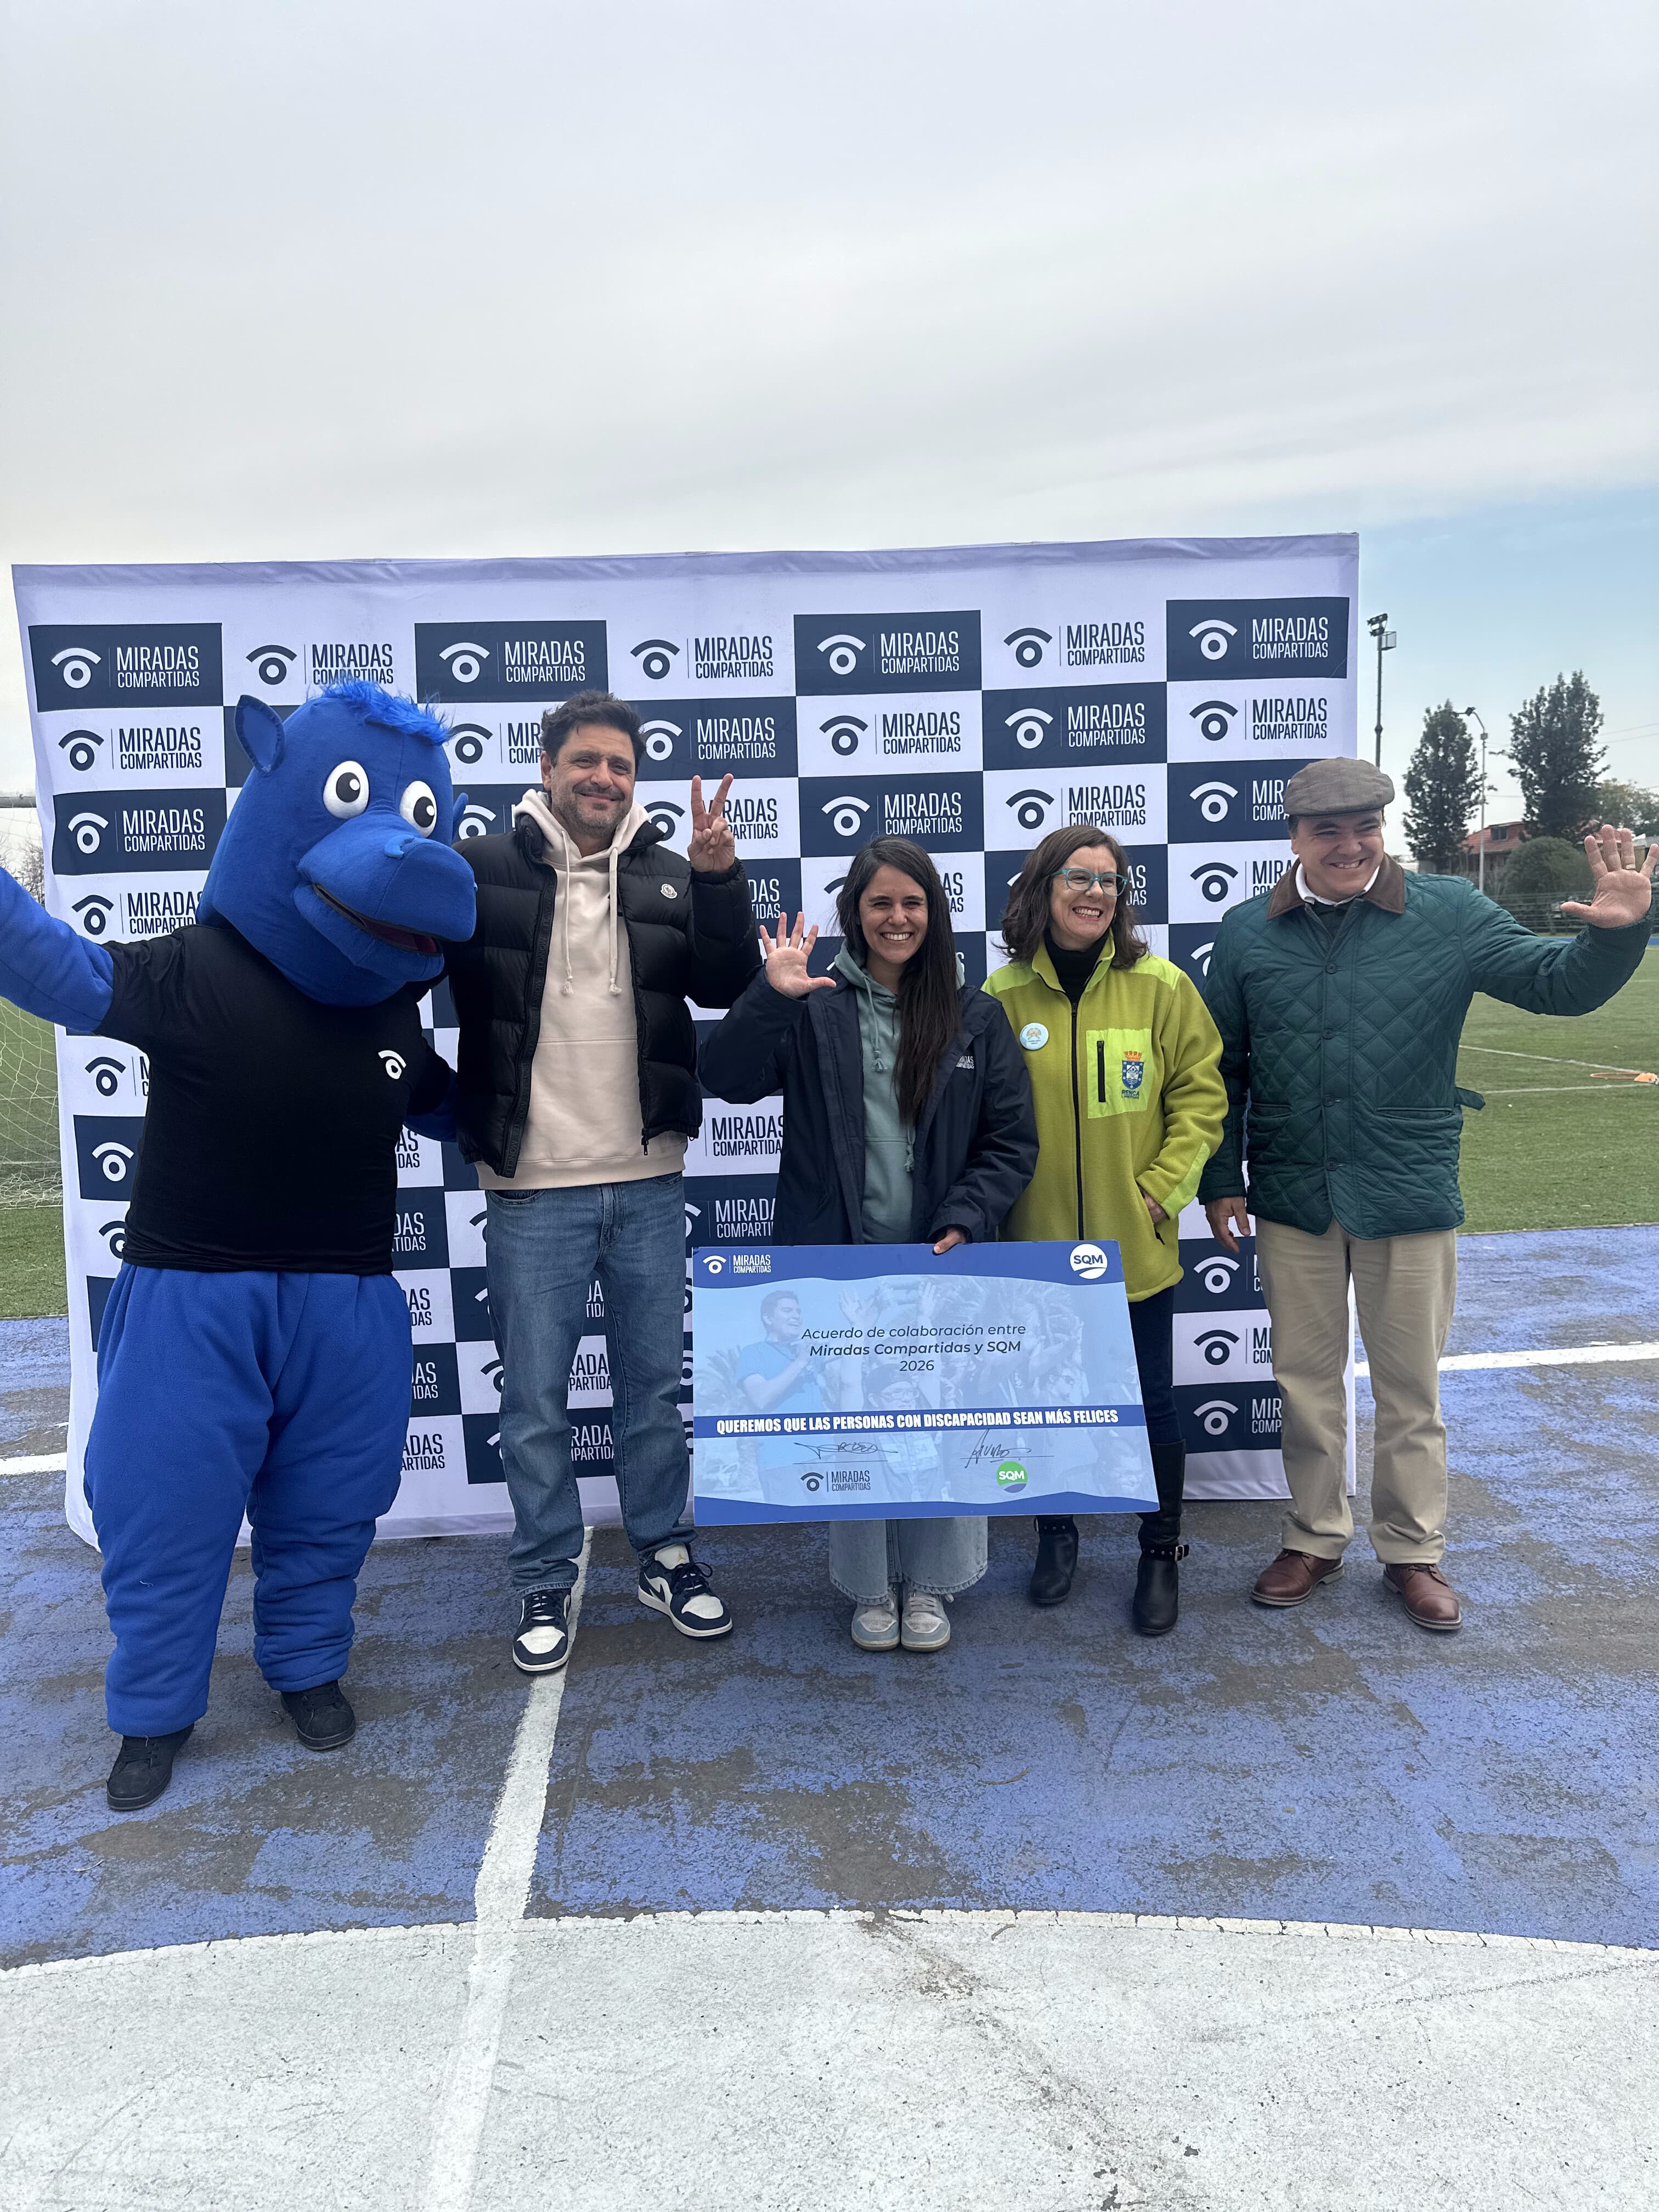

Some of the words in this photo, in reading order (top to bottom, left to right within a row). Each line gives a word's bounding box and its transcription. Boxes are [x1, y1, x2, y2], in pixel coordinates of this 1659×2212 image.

[1067, 622, 1144, 649] MIRADAS
[1253, 617, 1328, 642] MIRADAS
[695, 636, 772, 662] MIRADAS
[881, 631, 958, 657] MIRADAS
[1253, 642, 1328, 659] COMPARTIDAS
[117, 646, 198, 670] MIRADAS
[313, 644, 392, 668] MIRADAS
[505, 641, 584, 665] MIRADAS
[1068, 647, 1144, 665] COMPARTIDAS
[696, 661, 773, 679] COMPARTIDAS
[882, 656, 959, 673] COMPARTIDAS
[118, 671, 199, 687] COMPARTIDAS
[506, 666, 585, 682] COMPARTIDAS
[1068, 703, 1144, 730] MIRADAS
[1253, 698, 1327, 723] MIRADAS
[697, 718, 774, 742] MIRADAS
[883, 712, 960, 737] MIRADAS
[1254, 723, 1327, 740] COMPARTIDAS
[120, 727, 200, 752] MIRADAS
[884, 737, 961, 754] COMPARTIDAS
[1069, 728, 1145, 747] COMPARTIDAS
[698, 742, 775, 759] COMPARTIDAS
[121, 752, 201, 769] COMPARTIDAS
[885, 792, 961, 818] MIRADAS
[1069, 785, 1145, 811] MIRADAS
[702, 798, 777, 823] RADAS
[1069, 809, 1146, 827] COMPARTIDAS
[123, 809, 204, 834] MIRADAS
[886, 817, 962, 834] COMPARTIDAS
[728, 823, 778, 839] ARTIDAS
[125, 834, 205, 851] COMPARTIDAS
[129, 917, 194, 934] COMPARTID
[713, 1139, 781, 1156] COMPARTIDA
[715, 1198, 775, 1222] MIRAD
[717, 1221, 773, 1238] COMPARTI
[733, 1255, 770, 1266] MIRADAS
[1074, 1255, 1103, 1265] SQM
[802, 1327, 862, 1339] Acuerdo
[867, 1327, 884, 1337] de
[889, 1324, 983, 1336] colaboración
[988, 1325, 1025, 1334] entre
[810, 1344, 870, 1356] Miradas
[874, 1342, 970, 1356] Compartidas
[974, 1344, 983, 1355] y
[987, 1341, 1020, 1353] SQM
[900, 1360, 934, 1371] 2026
[569, 1376, 611, 1391] PARTIDA
[717, 1419, 781, 1434] QUEREMOS
[784, 1418, 806, 1432] QUE
[809, 1417, 831, 1430] LAS
[833, 1415, 894, 1429] PERSONAS
[897, 1415, 921, 1427] CON
[924, 1413, 1011, 1426] DISCAPACIDAD
[1013, 1412, 1043, 1425] SEAN
[1046, 1409, 1072, 1424] MÁS
[1074, 1410, 1118, 1423] FELICES
[571, 1425, 613, 1447] RADA
[403, 1434, 443, 1456] ADAS
[402, 1455, 445, 1471] ARTIDAS
[832, 1470, 870, 1483] MIRADAS
[999, 1471, 1024, 1480] SQM
[832, 1482, 871, 1491] COMPARTIDAS
